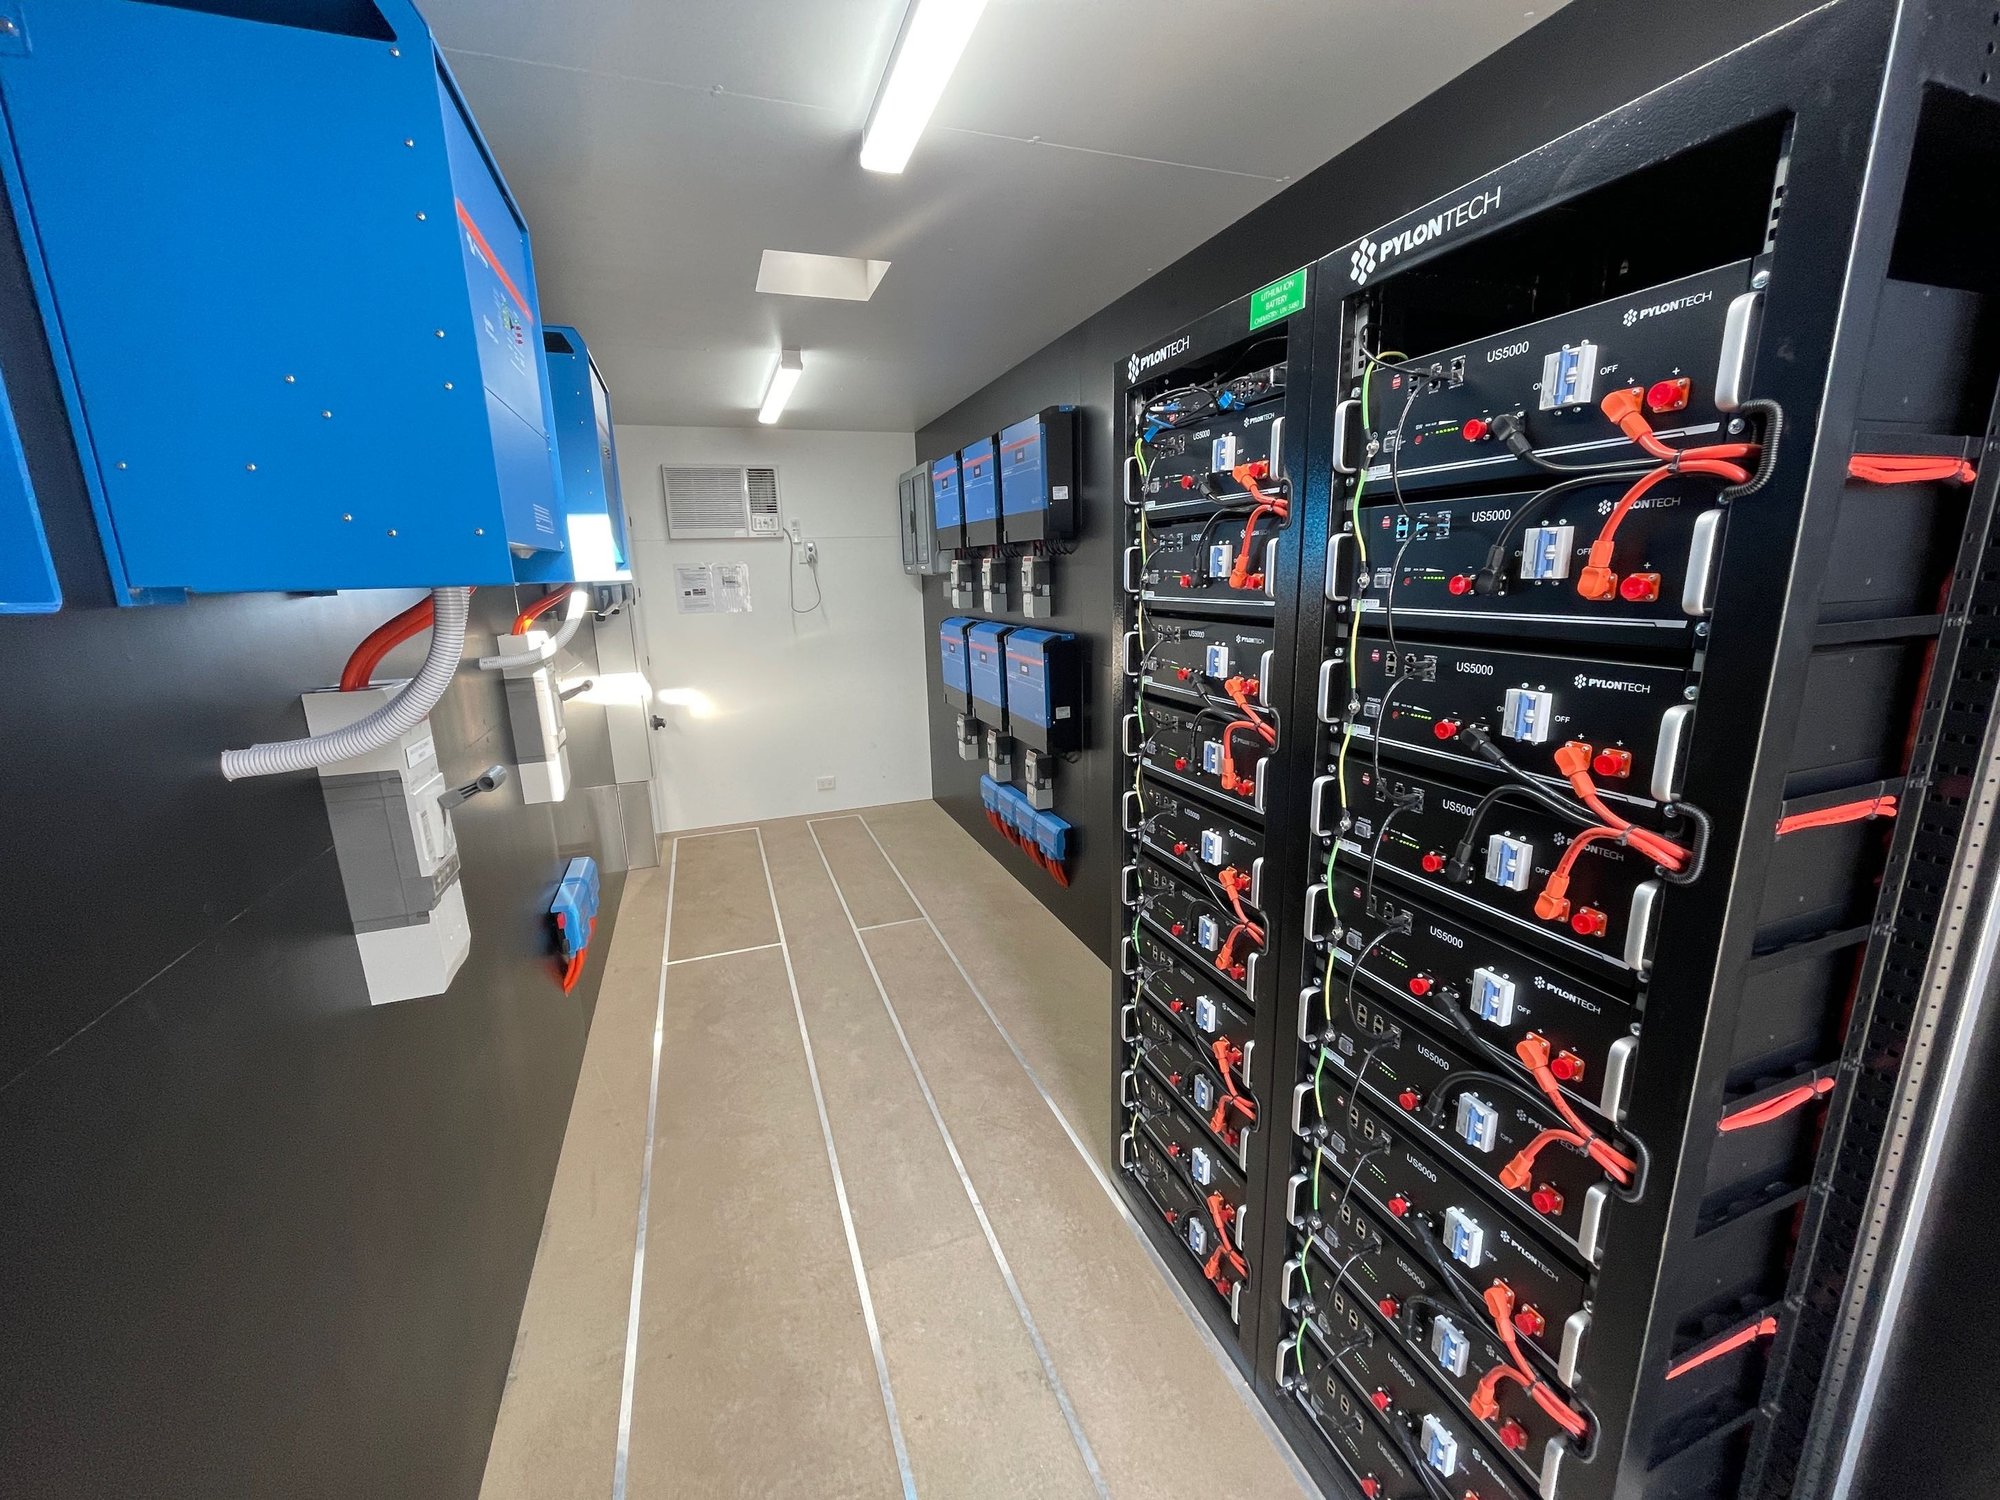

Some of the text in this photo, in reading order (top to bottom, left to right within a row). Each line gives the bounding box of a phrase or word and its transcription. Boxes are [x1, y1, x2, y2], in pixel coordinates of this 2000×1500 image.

[1380, 186, 1502, 264] PYLONTECH
[1265, 294, 1288, 311] BATTERY
[1639, 291, 1713, 320] PYLONTECH
[1140, 335, 1190, 371] PYLONTECH
[1487, 341, 1530, 363] US5000
[1599, 364, 1619, 376] OFF
[1192, 429, 1211, 441] US5000
[1614, 496, 1681, 511] PONTECH
[1471, 509, 1511, 523] US5000
[1456, 661, 1494, 676] US5000
[1588, 677, 1651, 694] PYLONTECH
[1554, 714, 1571, 723] OFF
[1567, 837, 1625, 862] PONTECH
[1535, 867, 1550, 876] OFF
[1429, 925, 1464, 949] US5000
[1546, 982, 1601, 1015] PYLONTECH
[1517, 1004, 1532, 1016] OFF
[1417, 1043, 1450, 1071] US5000
[1406, 1152, 1438, 1183] US5000
[1511, 1238, 1559, 1283] PYLONTECH
[1396, 1256, 1426, 1290] US5000
